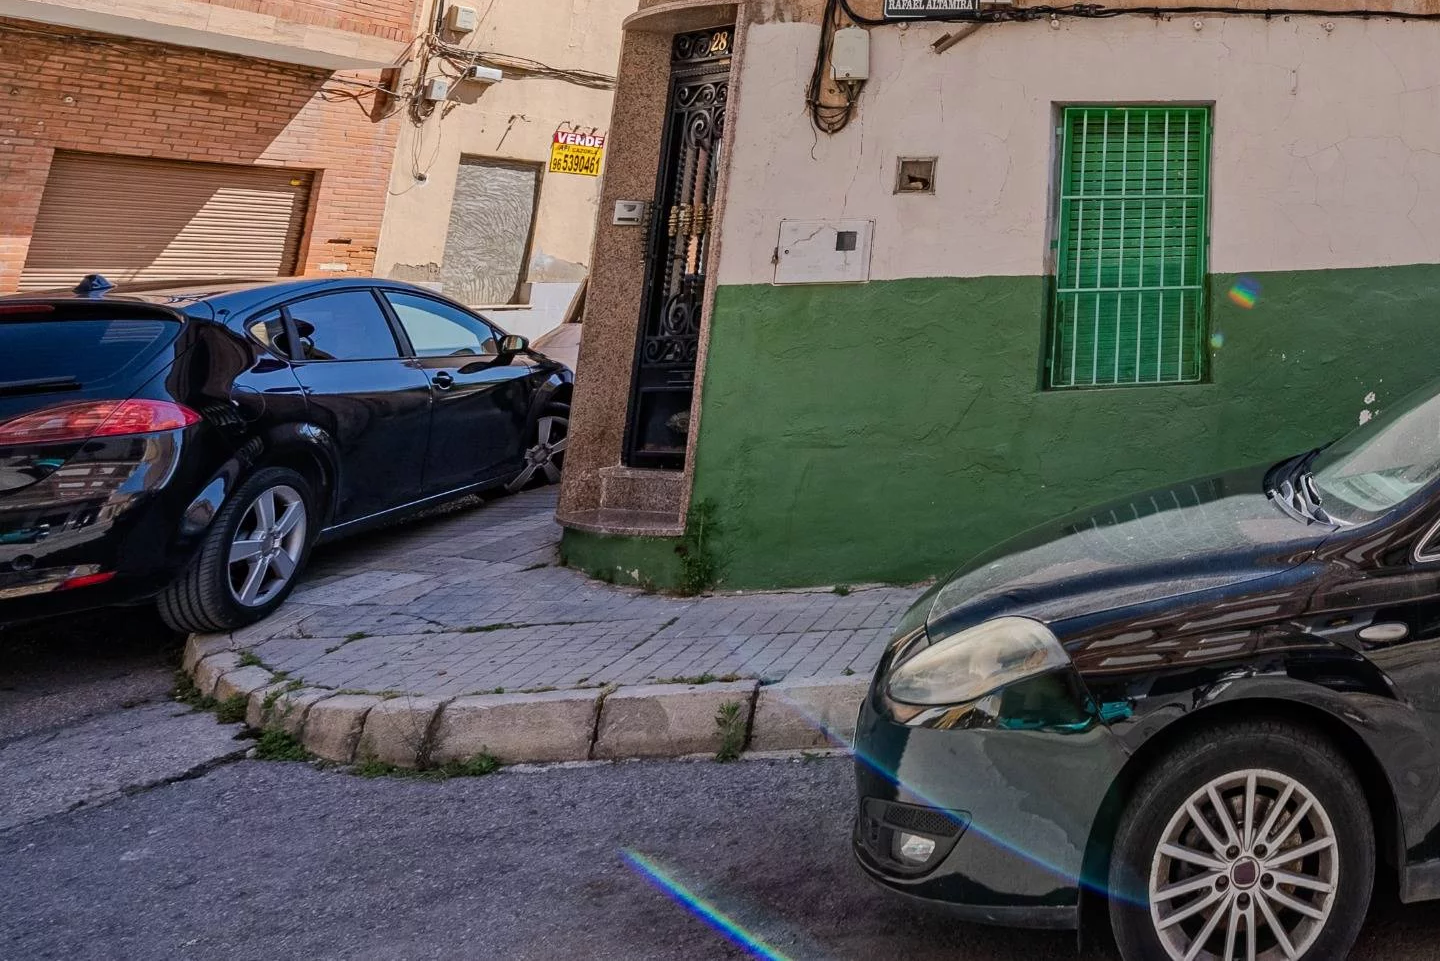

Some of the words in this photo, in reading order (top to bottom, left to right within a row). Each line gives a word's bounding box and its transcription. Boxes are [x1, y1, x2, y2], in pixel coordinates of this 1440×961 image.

[888, 0, 925, 10] RAFAEL
[925, 0, 973, 10] ALTAMIRA
[711, 31, 728, 52] 28
[557, 131, 604, 148] VENDE
